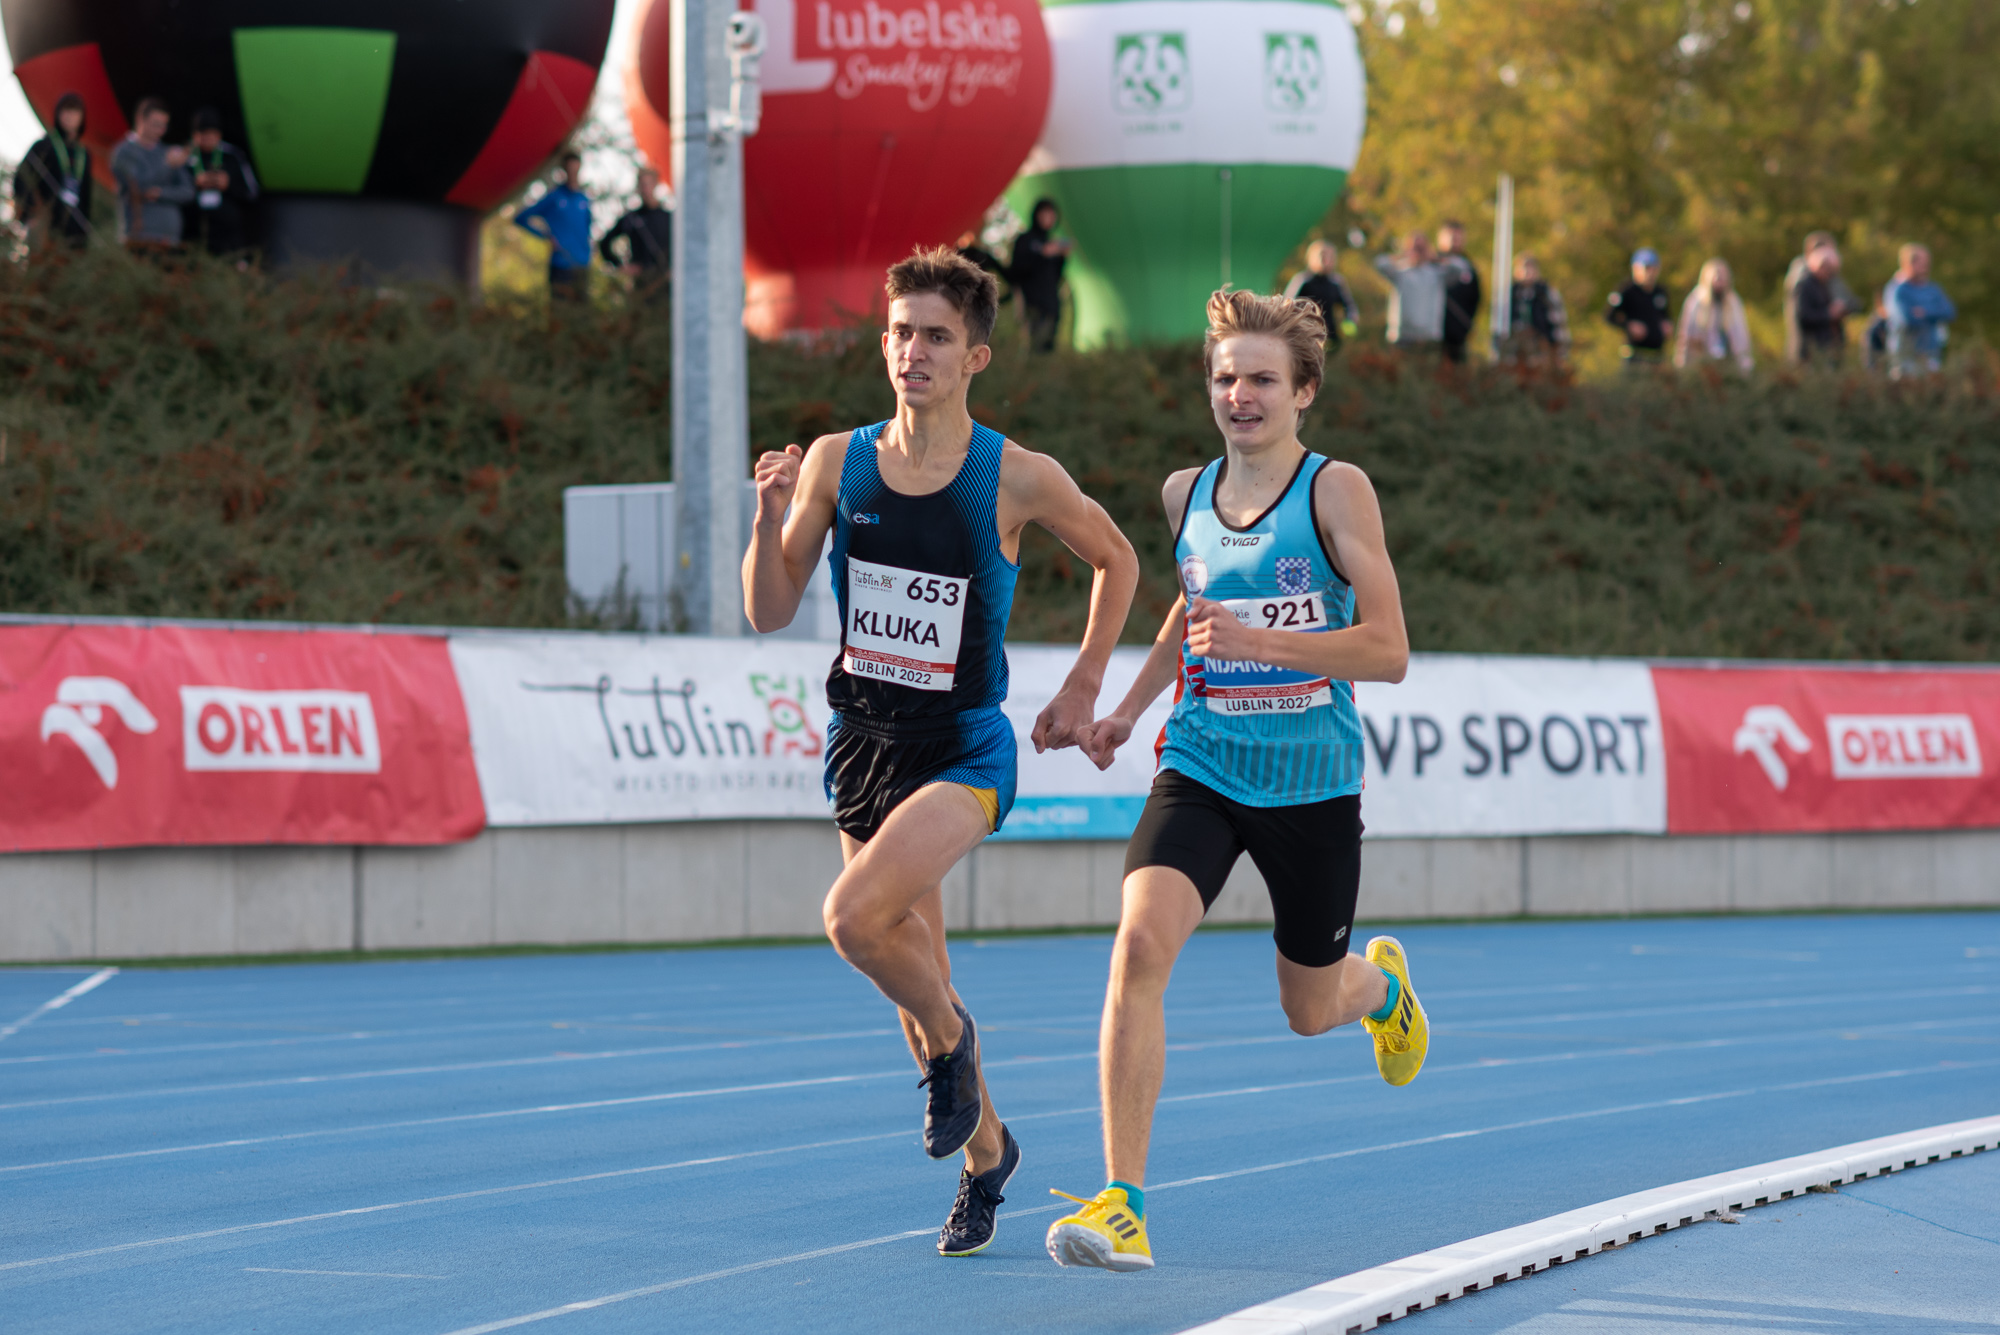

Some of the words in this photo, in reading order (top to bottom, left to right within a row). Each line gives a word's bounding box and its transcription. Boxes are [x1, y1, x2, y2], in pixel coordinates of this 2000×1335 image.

[816, 0, 1022, 52] lubelskie
[853, 512, 880, 525] esa
[906, 576, 960, 607] 653
[853, 607, 940, 648] KLUKA
[1262, 598, 1319, 629] 921
[852, 659, 896, 678] LUBLIN
[899, 668, 932, 685] 2022
[1225, 699, 1273, 712] LUBLIN
[197, 700, 365, 758] ORLEN
[1361, 714, 1443, 776] VP
[1461, 713, 1650, 777] SPORT
[1840, 725, 1968, 769] ORLEN
